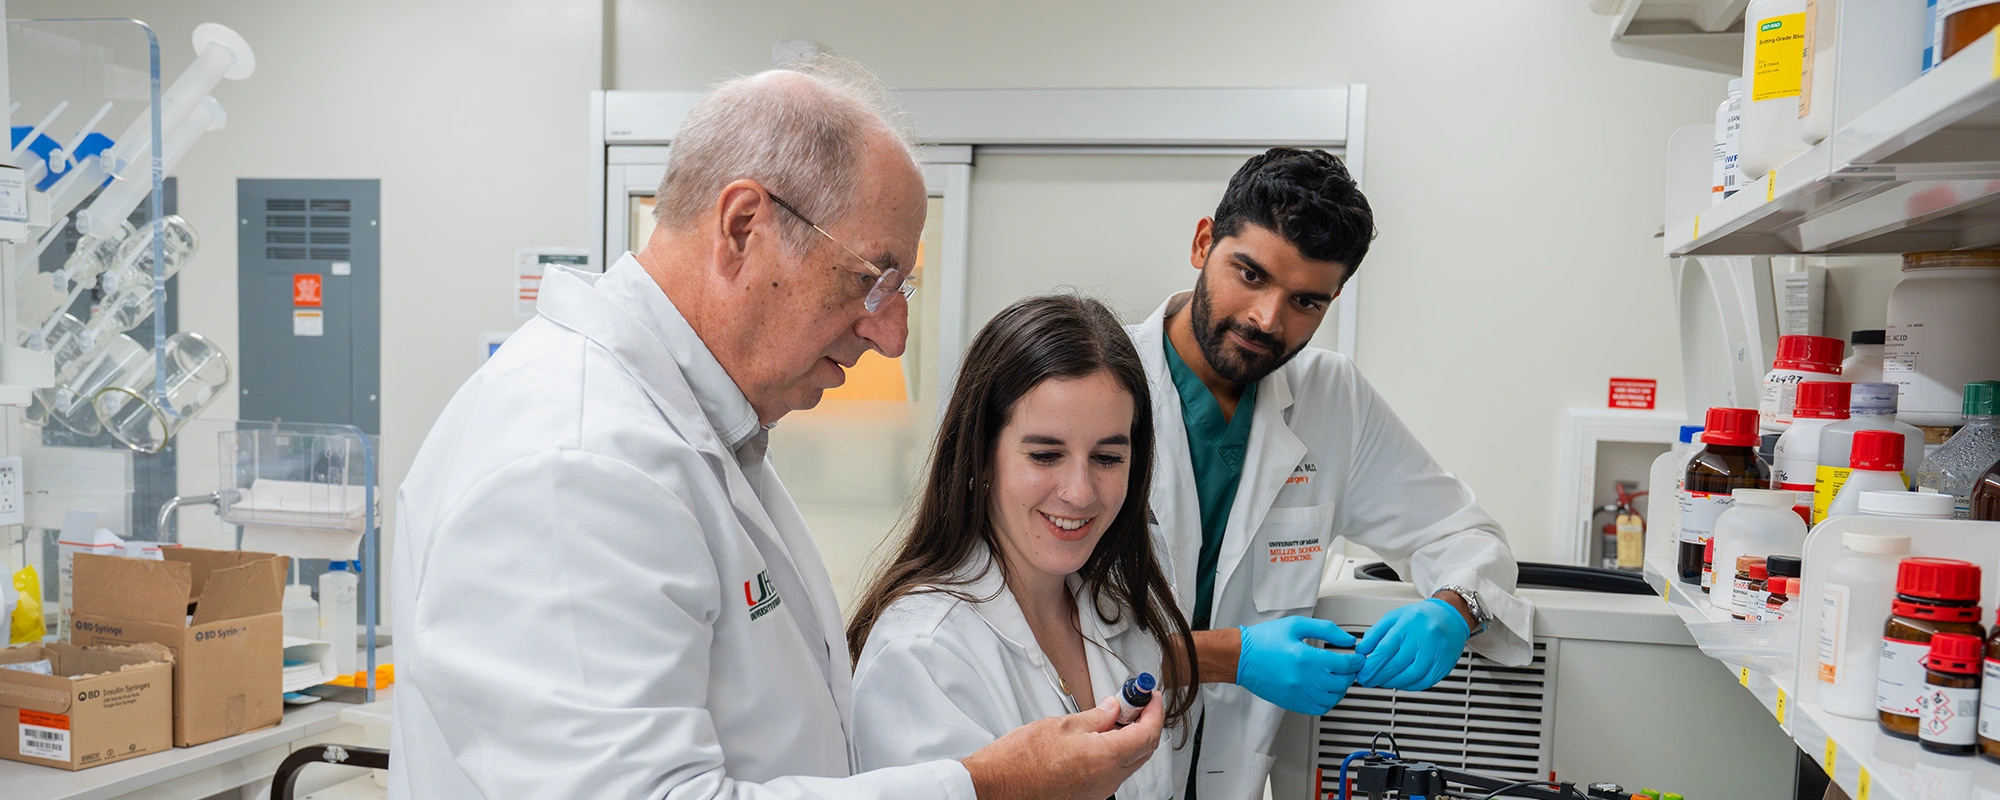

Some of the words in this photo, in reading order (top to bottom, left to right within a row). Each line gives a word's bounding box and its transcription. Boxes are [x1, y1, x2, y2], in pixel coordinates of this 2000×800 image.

[1762, 22, 1781, 31] BIO-RAD
[1270, 548, 1297, 556] MILLER
[1298, 545, 1323, 554] SCHOOL
[83, 621, 94, 631] BD
[94, 623, 123, 636] Syringe
[204, 631, 216, 640] BD
[88, 690, 101, 700] BD
[103, 686, 125, 697] Insulin
[125, 682, 151, 694] Syringes
